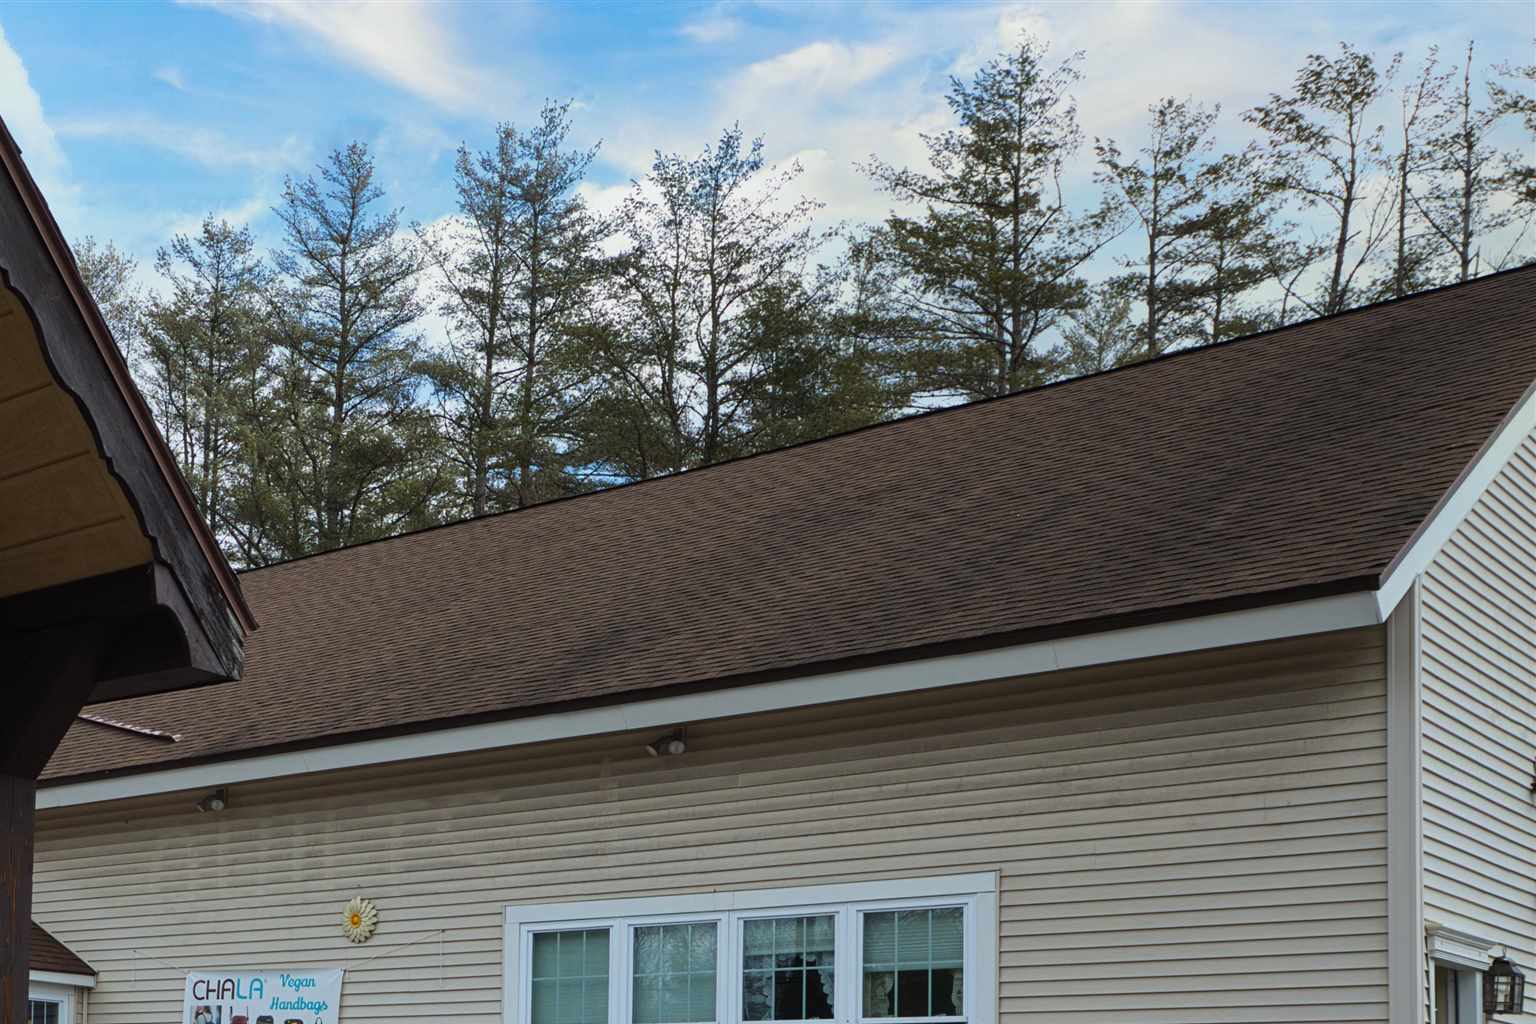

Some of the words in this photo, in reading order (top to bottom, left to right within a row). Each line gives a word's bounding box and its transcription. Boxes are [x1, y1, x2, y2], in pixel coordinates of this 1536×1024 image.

[193, 979, 263, 1000] CHALA
[280, 975, 315, 991] Vegan
[270, 997, 328, 1015] Handbags
